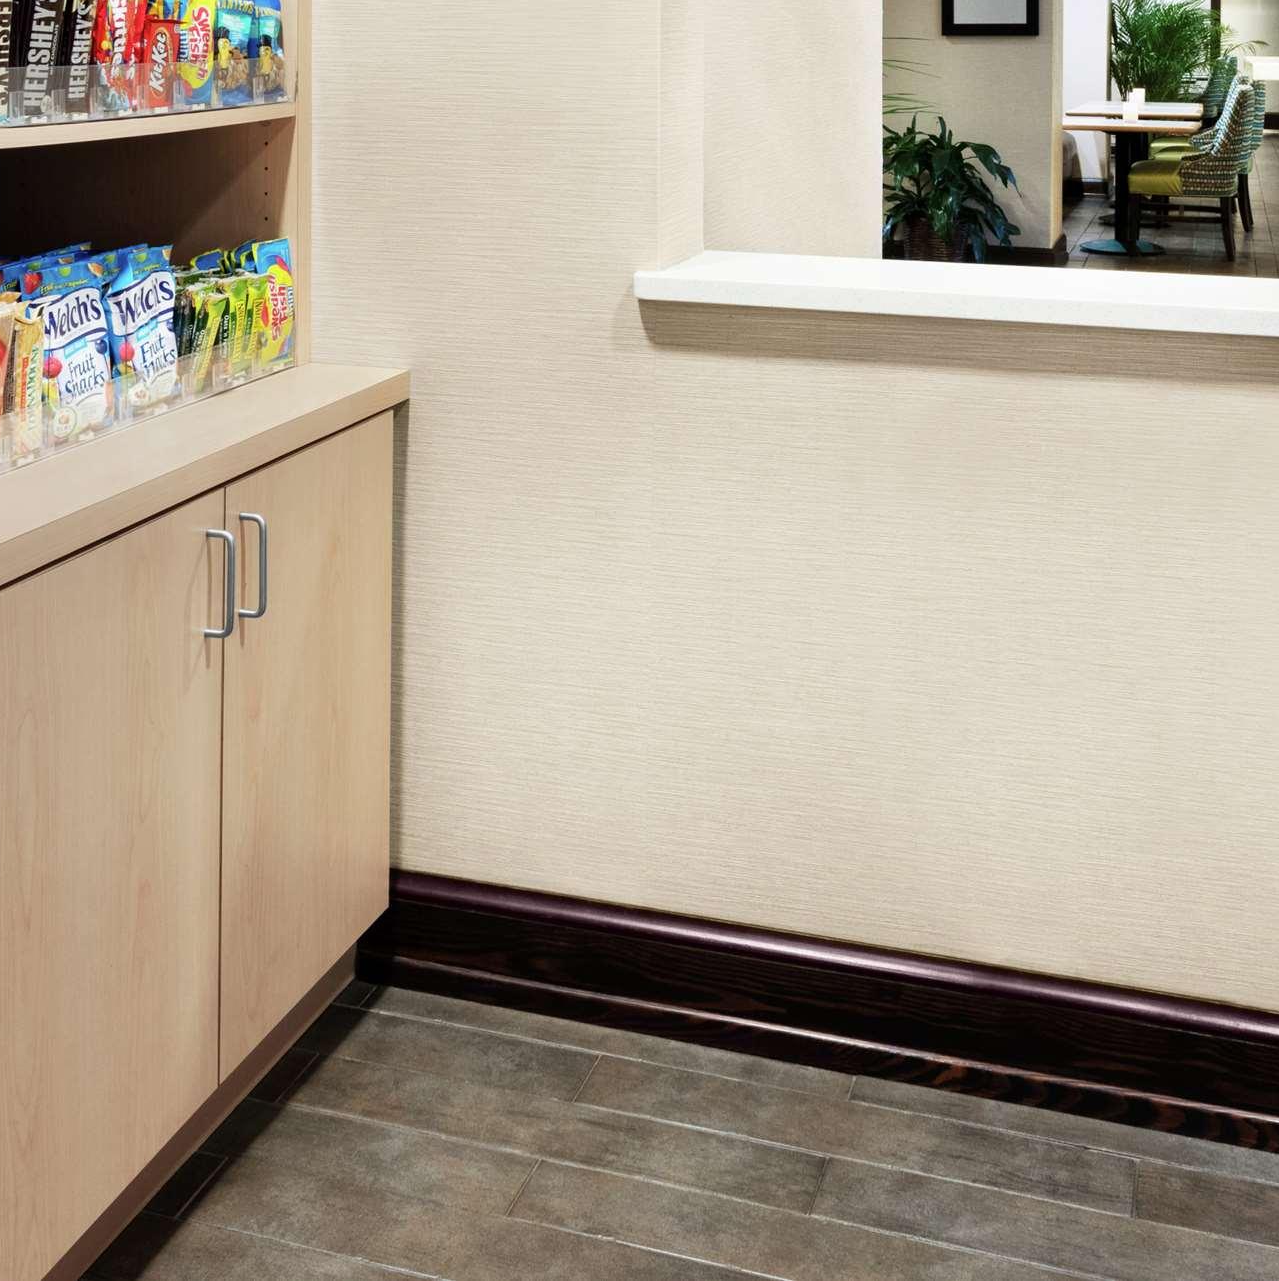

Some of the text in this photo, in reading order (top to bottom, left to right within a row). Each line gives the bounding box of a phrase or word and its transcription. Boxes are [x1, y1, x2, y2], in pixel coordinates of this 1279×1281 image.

[68, 3, 94, 99] HERSHEY'S
[44, 294, 102, 341] Welch's
[70, 352, 96, 380] Fruit
